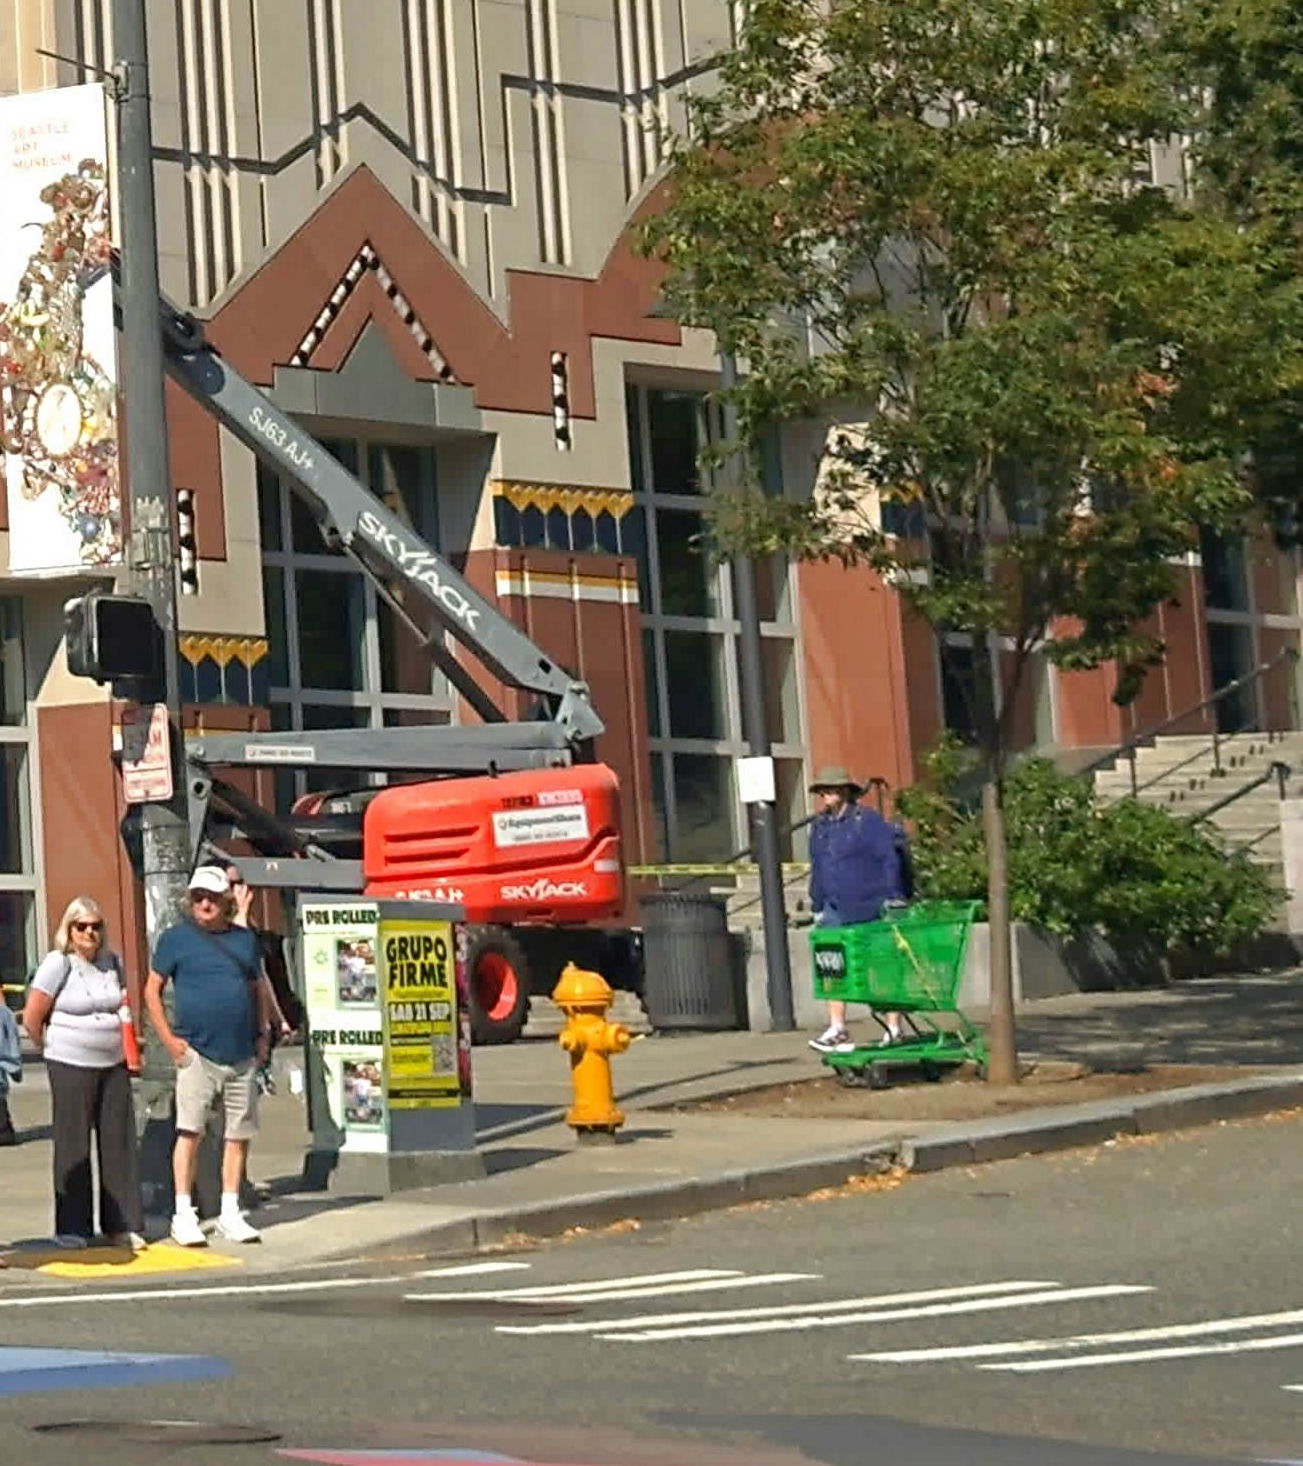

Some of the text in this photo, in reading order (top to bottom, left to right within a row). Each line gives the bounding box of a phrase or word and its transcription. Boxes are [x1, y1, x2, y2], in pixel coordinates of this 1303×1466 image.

[249, 406, 287, 447] SJ63
[357, 511, 481, 631] SKYJACK
[500, 877, 588, 901] SKYJACK
[305, 909, 377, 925] PRE ROLLED
[386, 934, 448, 963] GRUPO
[388, 961, 448, 989] FIRME
[311, 1030, 383, 1046] PRE ROLLED
